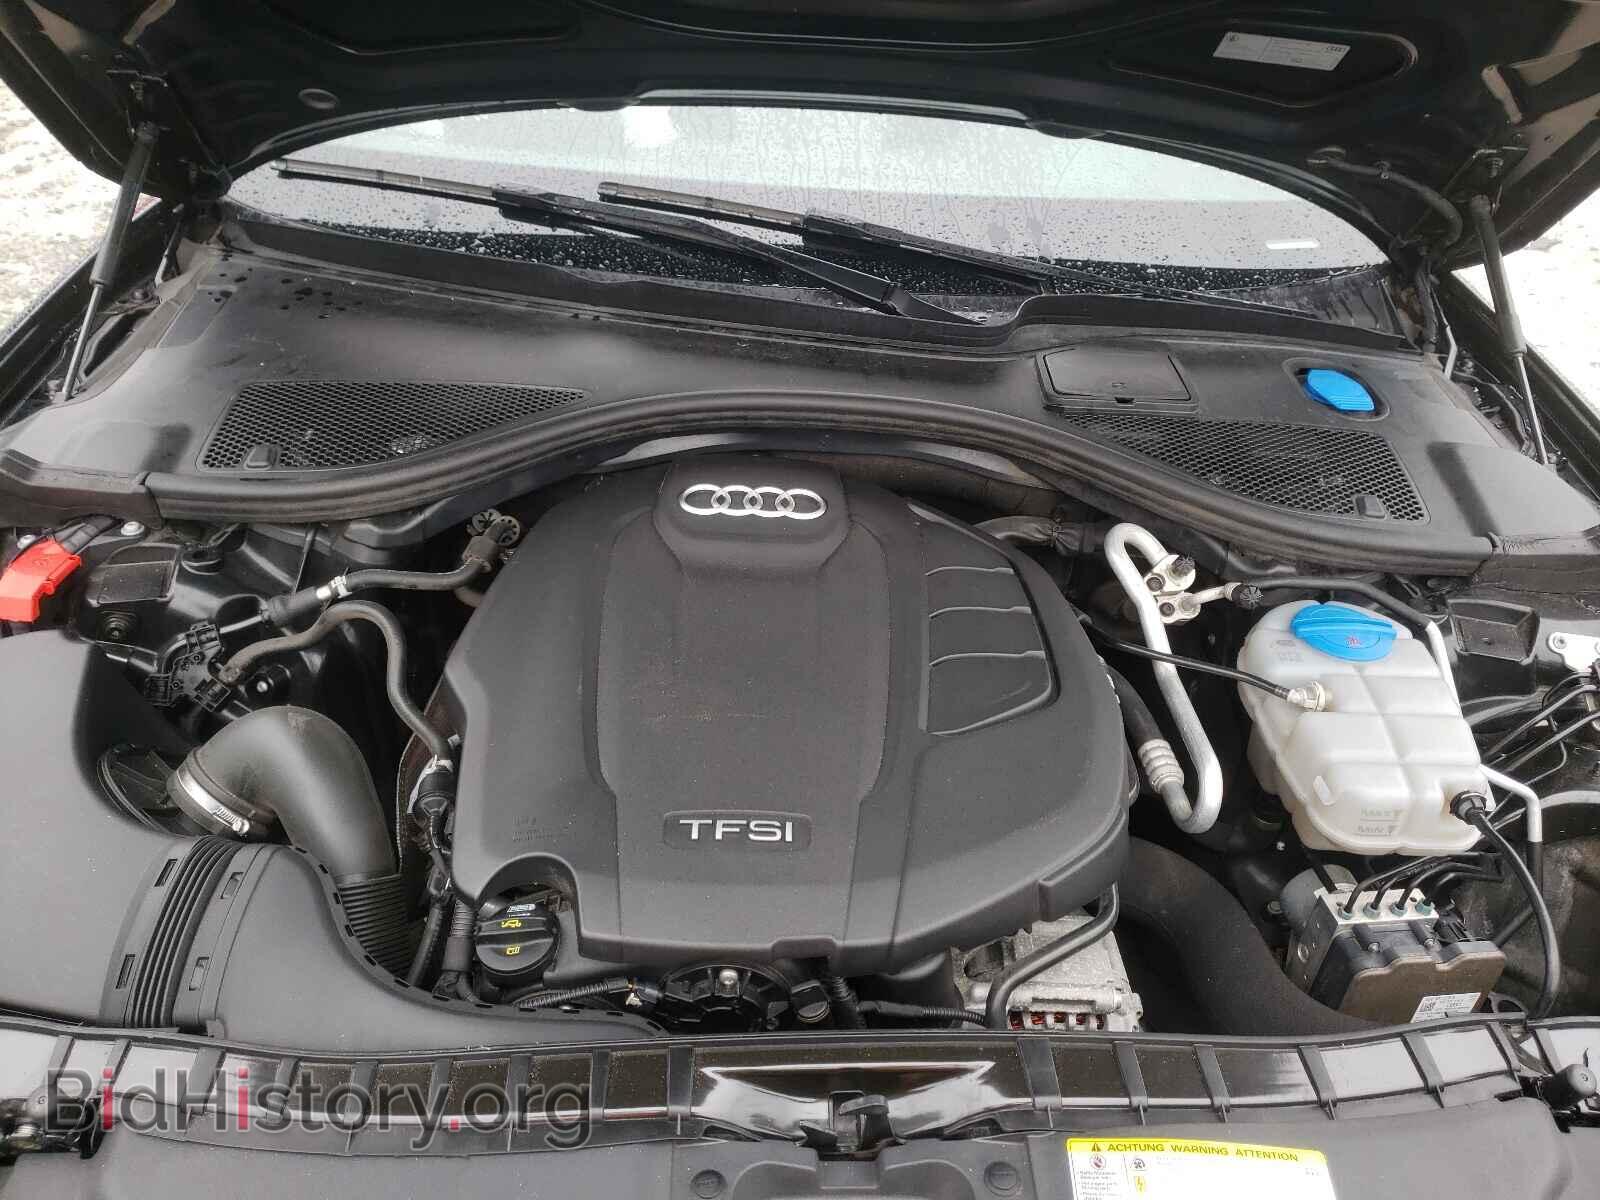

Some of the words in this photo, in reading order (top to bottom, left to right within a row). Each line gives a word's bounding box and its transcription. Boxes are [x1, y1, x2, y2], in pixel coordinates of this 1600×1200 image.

[679, 819, 793, 842] TFSI
[1106, 1143, 1165, 1153] ACHTUNG
[1170, 1144, 1229, 1156] WARNING
[1235, 1148, 1299, 1162] ATTENTION
